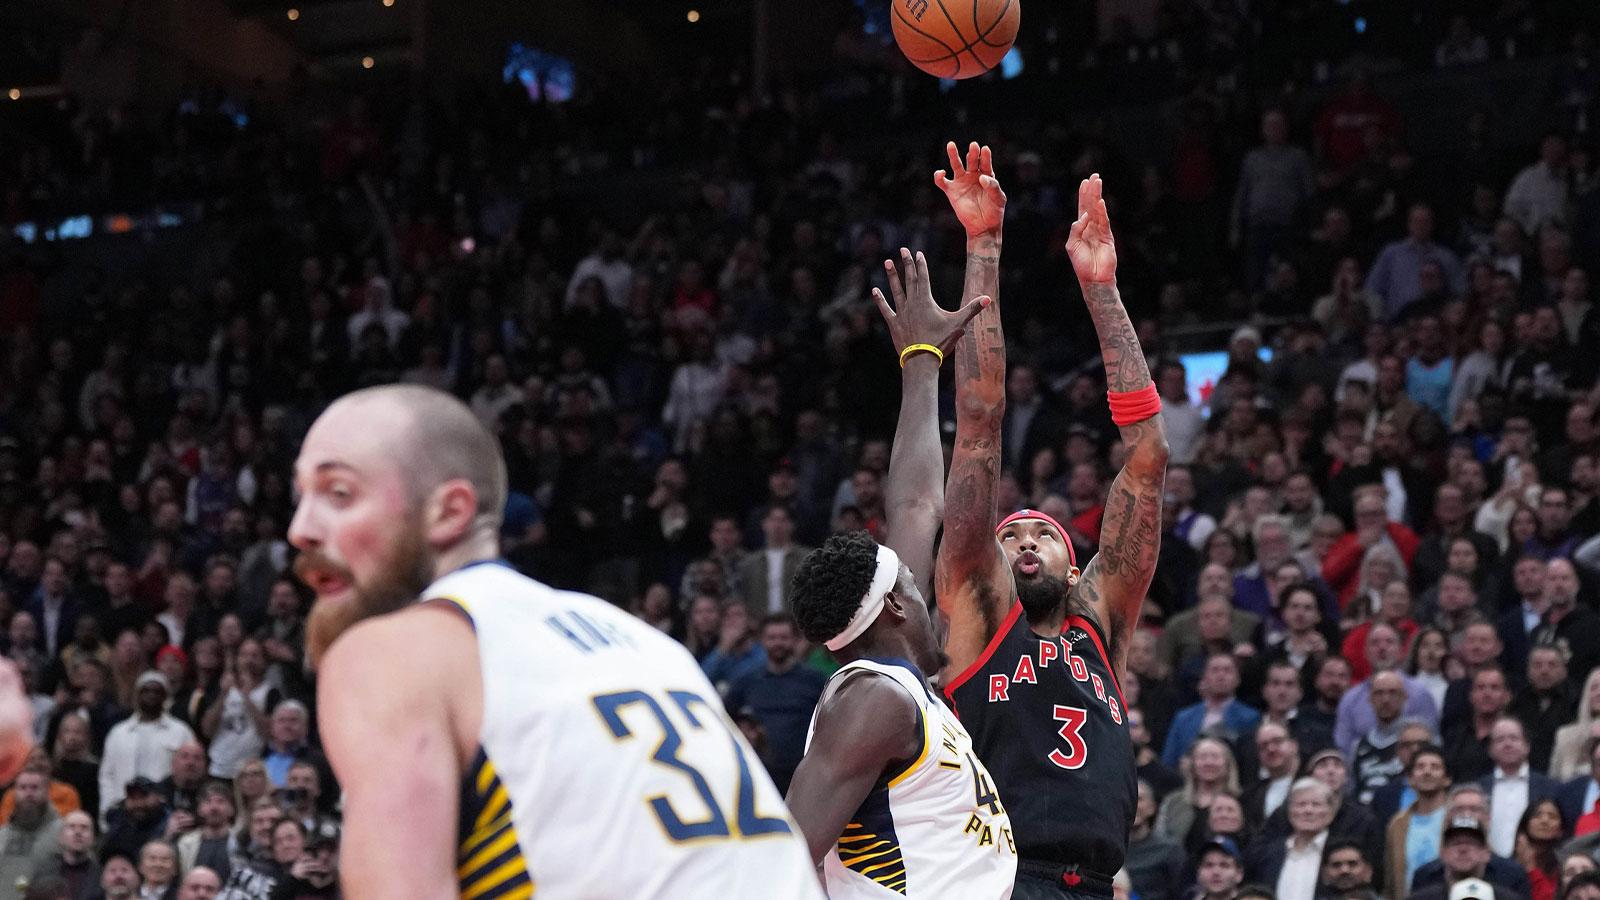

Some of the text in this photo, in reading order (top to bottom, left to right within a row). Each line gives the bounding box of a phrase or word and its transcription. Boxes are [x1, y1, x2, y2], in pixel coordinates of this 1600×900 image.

[989, 635, 1122, 725] RAPTORS
[590, 688, 792, 844] 32
[1048, 704, 1088, 770] 3
[964, 752, 1006, 816] 4
[963, 813, 1016, 856] PAE
